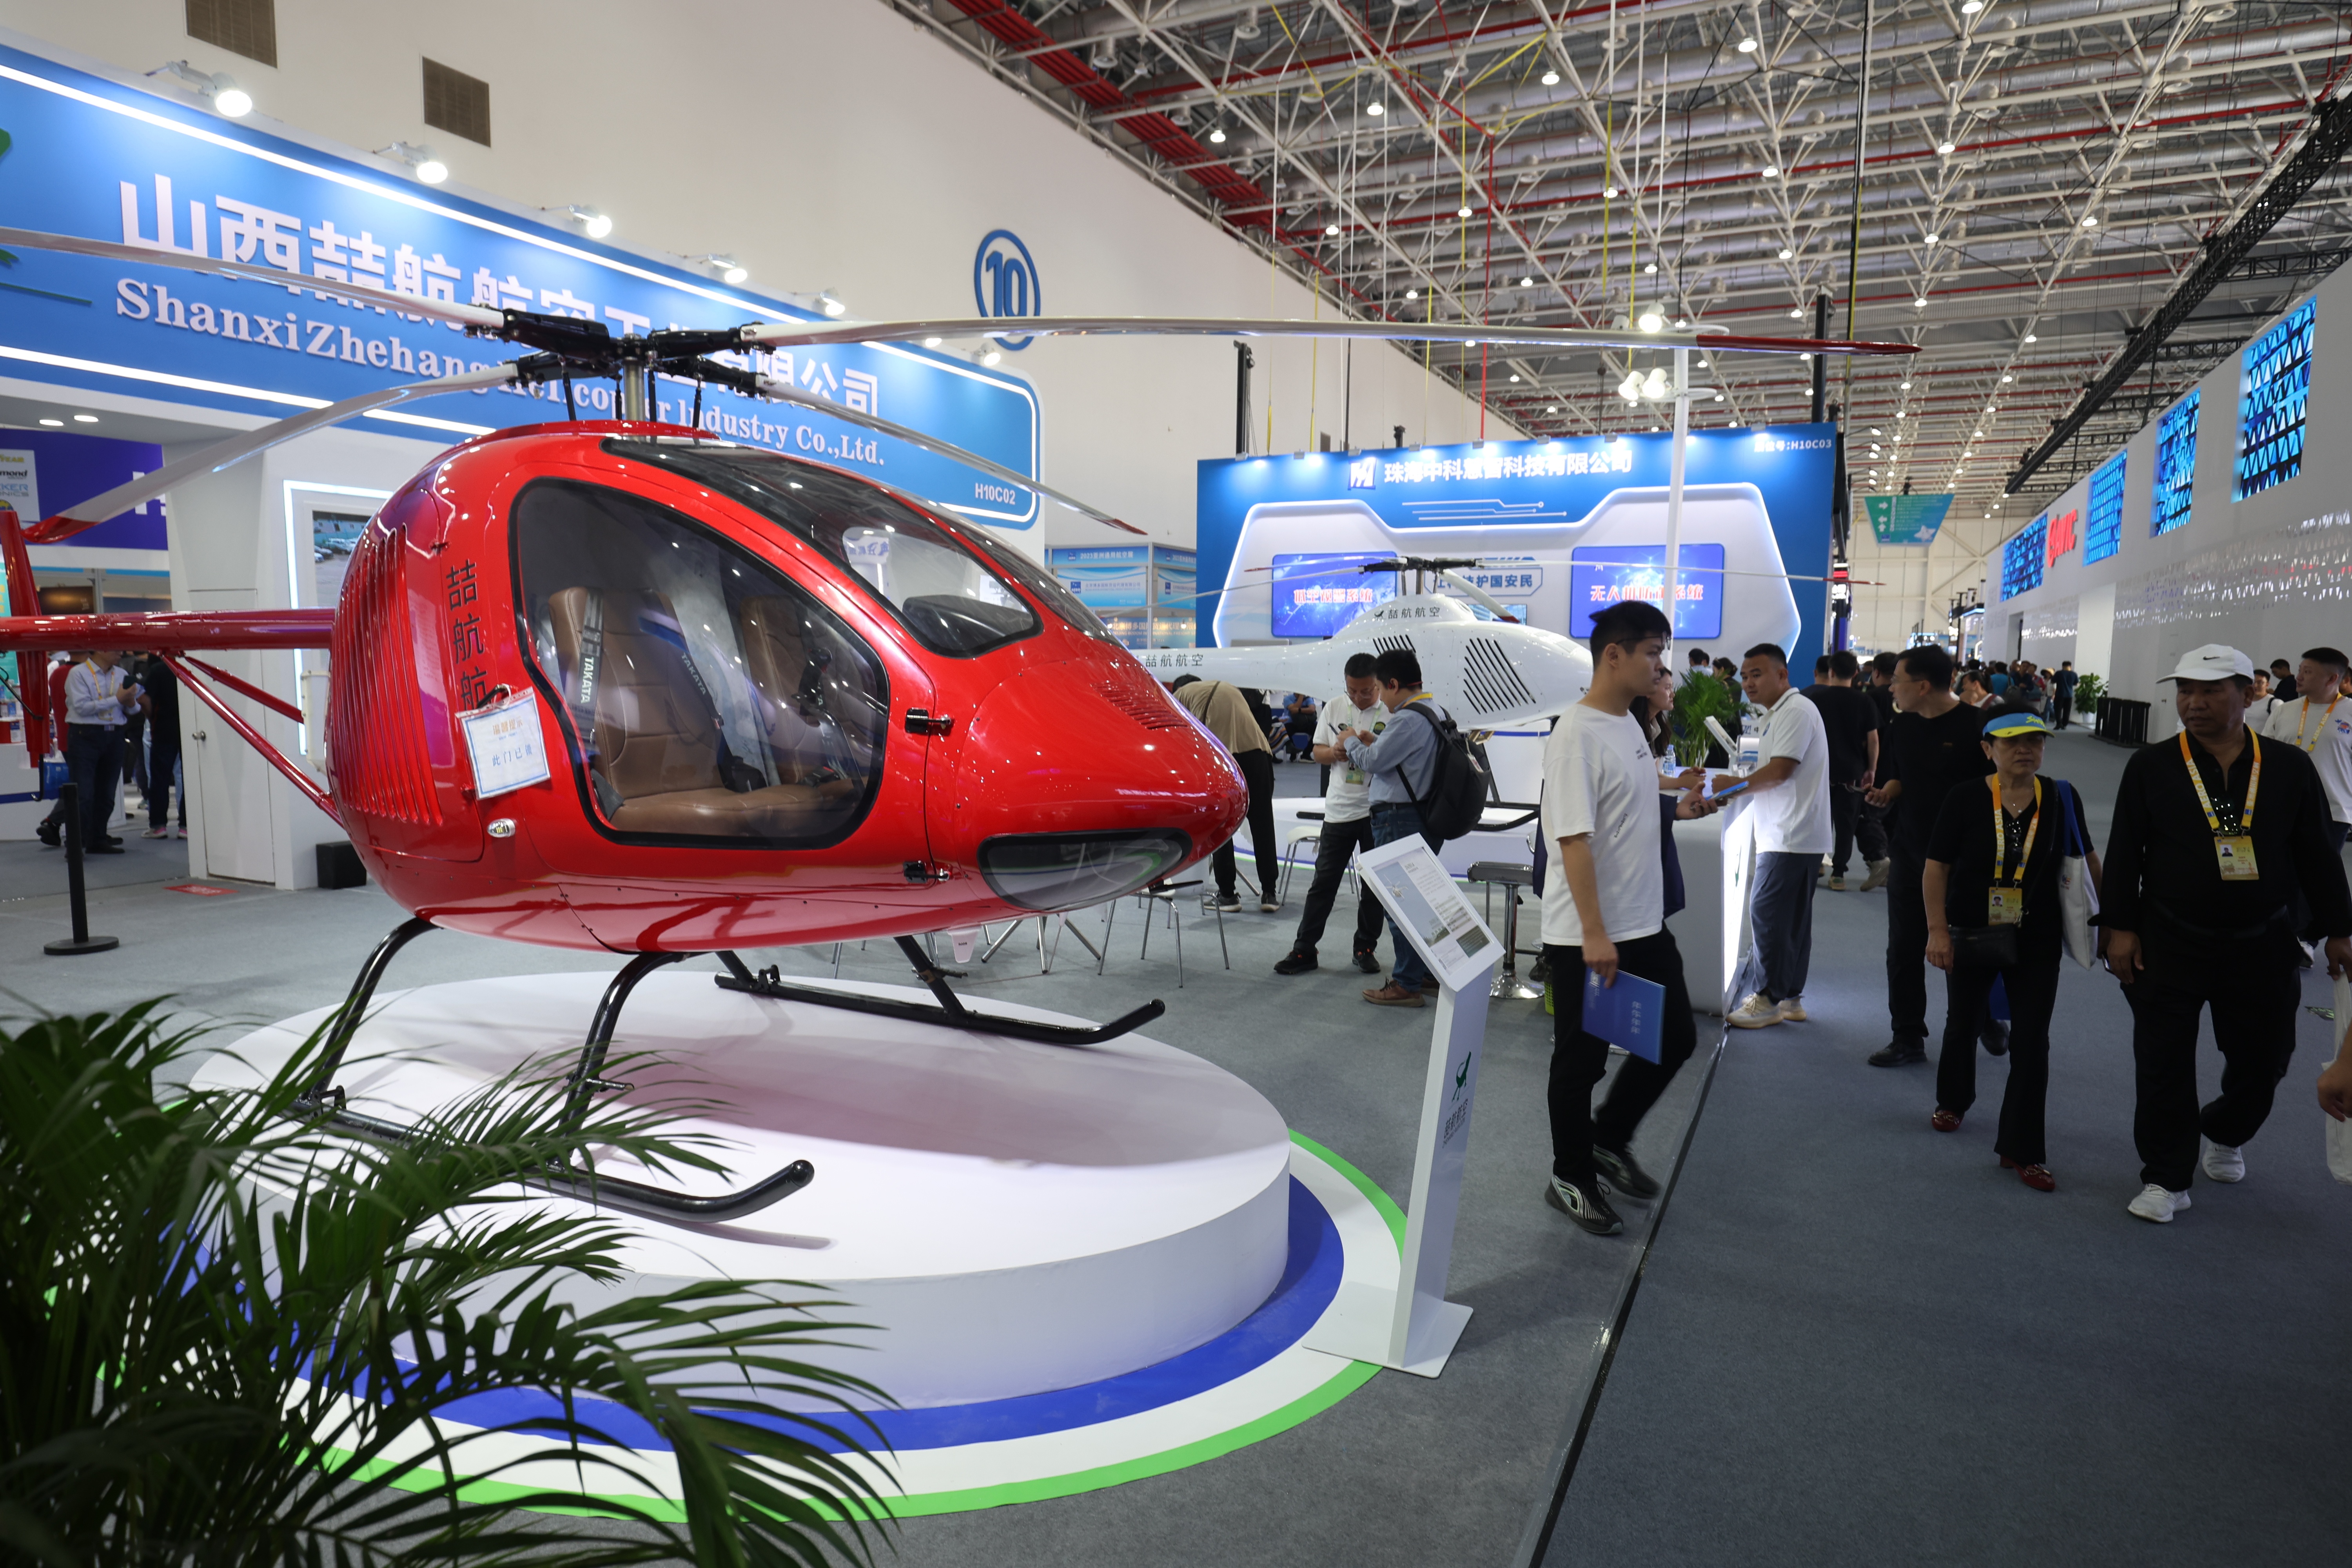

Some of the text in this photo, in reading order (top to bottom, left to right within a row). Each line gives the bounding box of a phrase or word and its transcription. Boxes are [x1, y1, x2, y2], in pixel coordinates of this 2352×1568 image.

[985, 250, 1027, 317] 10
[796, 425, 884, 465] Co.,Ltd.
[975, 483, 1016, 505] H10C02
[581, 656, 594, 704] TAKATA
[682, 652, 706, 695] TAKATA
[1145, 653, 1203, 667] 喆航航空
[492, 744, 532, 766] 此门已锁
[2186, 758, 2213, 808] AERO ASIA
[1994, 809, 2005, 857] AERO ASIA
